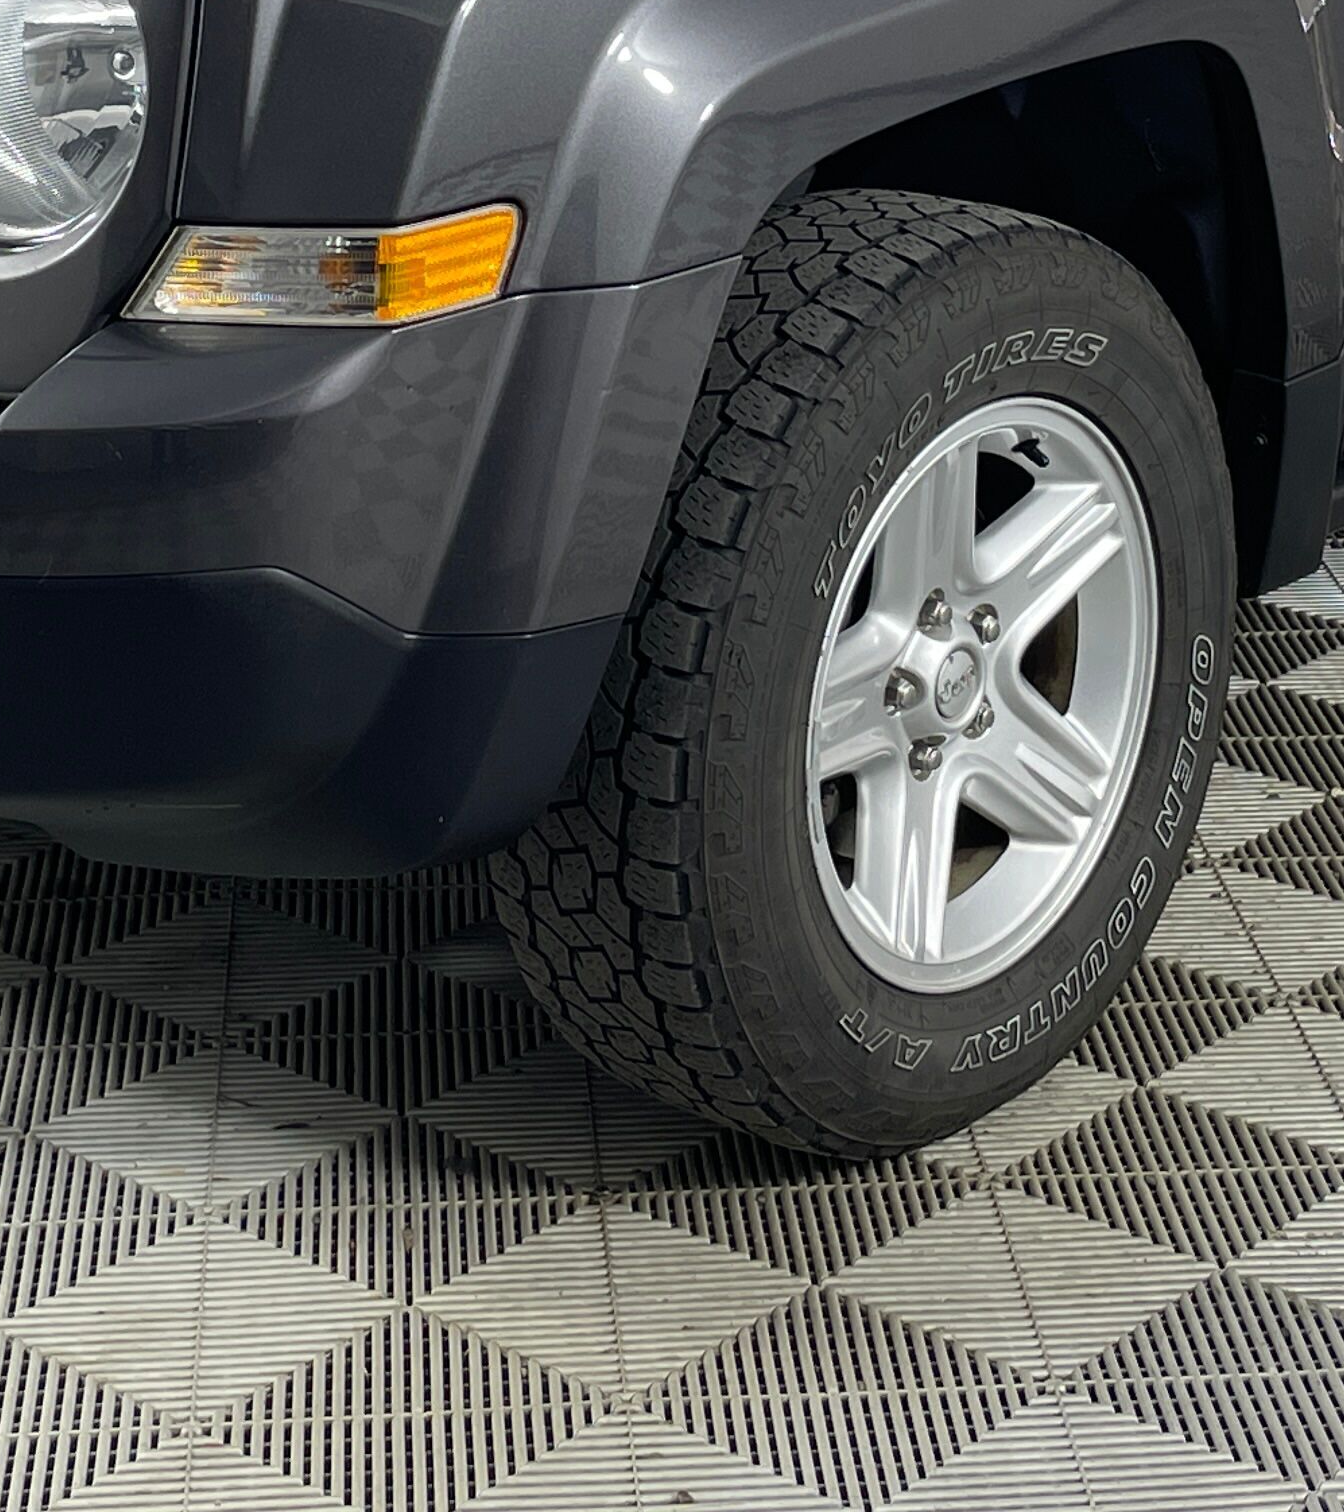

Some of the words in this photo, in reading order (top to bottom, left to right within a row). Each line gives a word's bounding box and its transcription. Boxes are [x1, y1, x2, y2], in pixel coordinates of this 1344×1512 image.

[813, 393, 933, 600] TOYO
[943, 328, 1108, 403] TIRES
[1154, 633, 1215, 849] OPEN
[839, 1007, 933, 1071] A/T
[950, 855, 1156, 1073] COUNTRY
